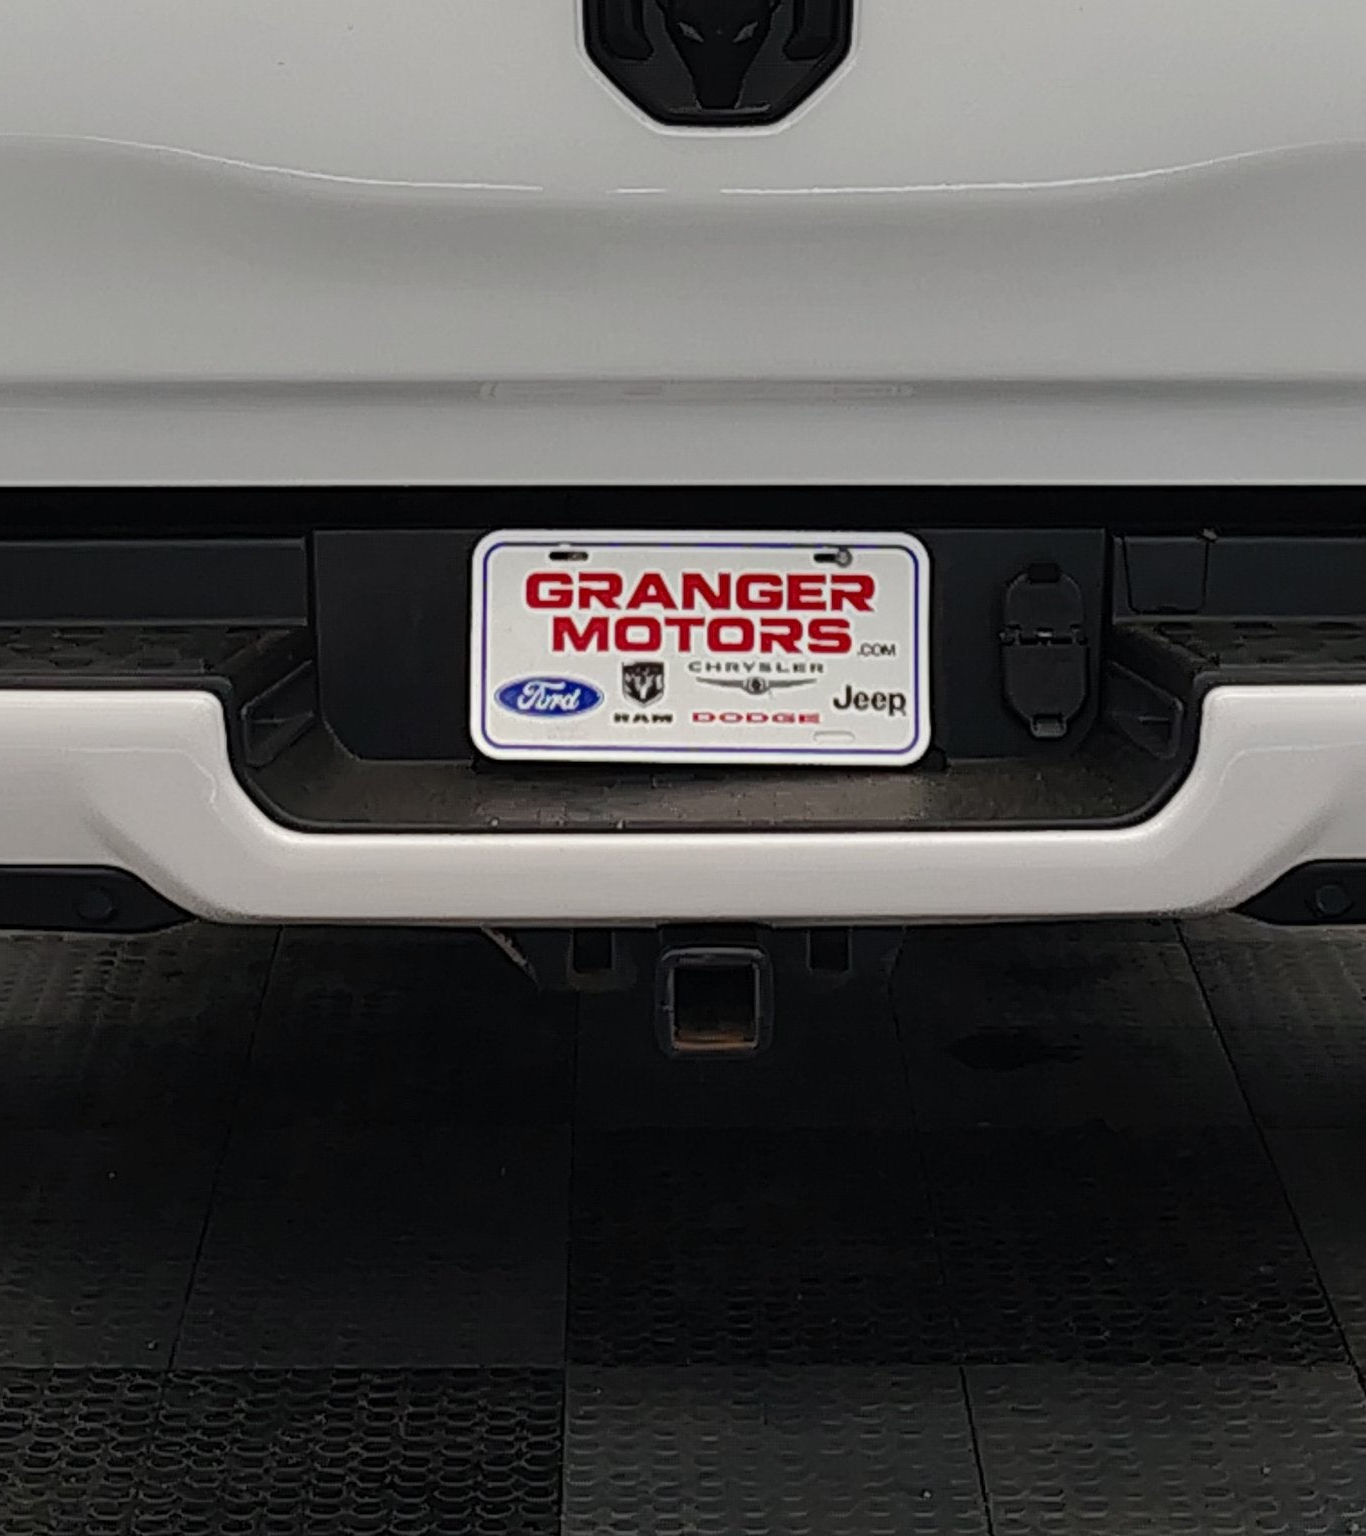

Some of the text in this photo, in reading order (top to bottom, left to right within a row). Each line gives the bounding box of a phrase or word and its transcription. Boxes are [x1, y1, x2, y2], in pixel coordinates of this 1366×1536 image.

[525, 571, 876, 612] GRANGER
[551, 616, 853, 655] MOTORS
[687, 661, 825, 674] CHRYSLER
[516, 680, 582, 711] Ford
[833, 684, 907, 716] Jeep
[614, 712, 673, 724] RAM
[692, 712, 821, 724] DODGE
